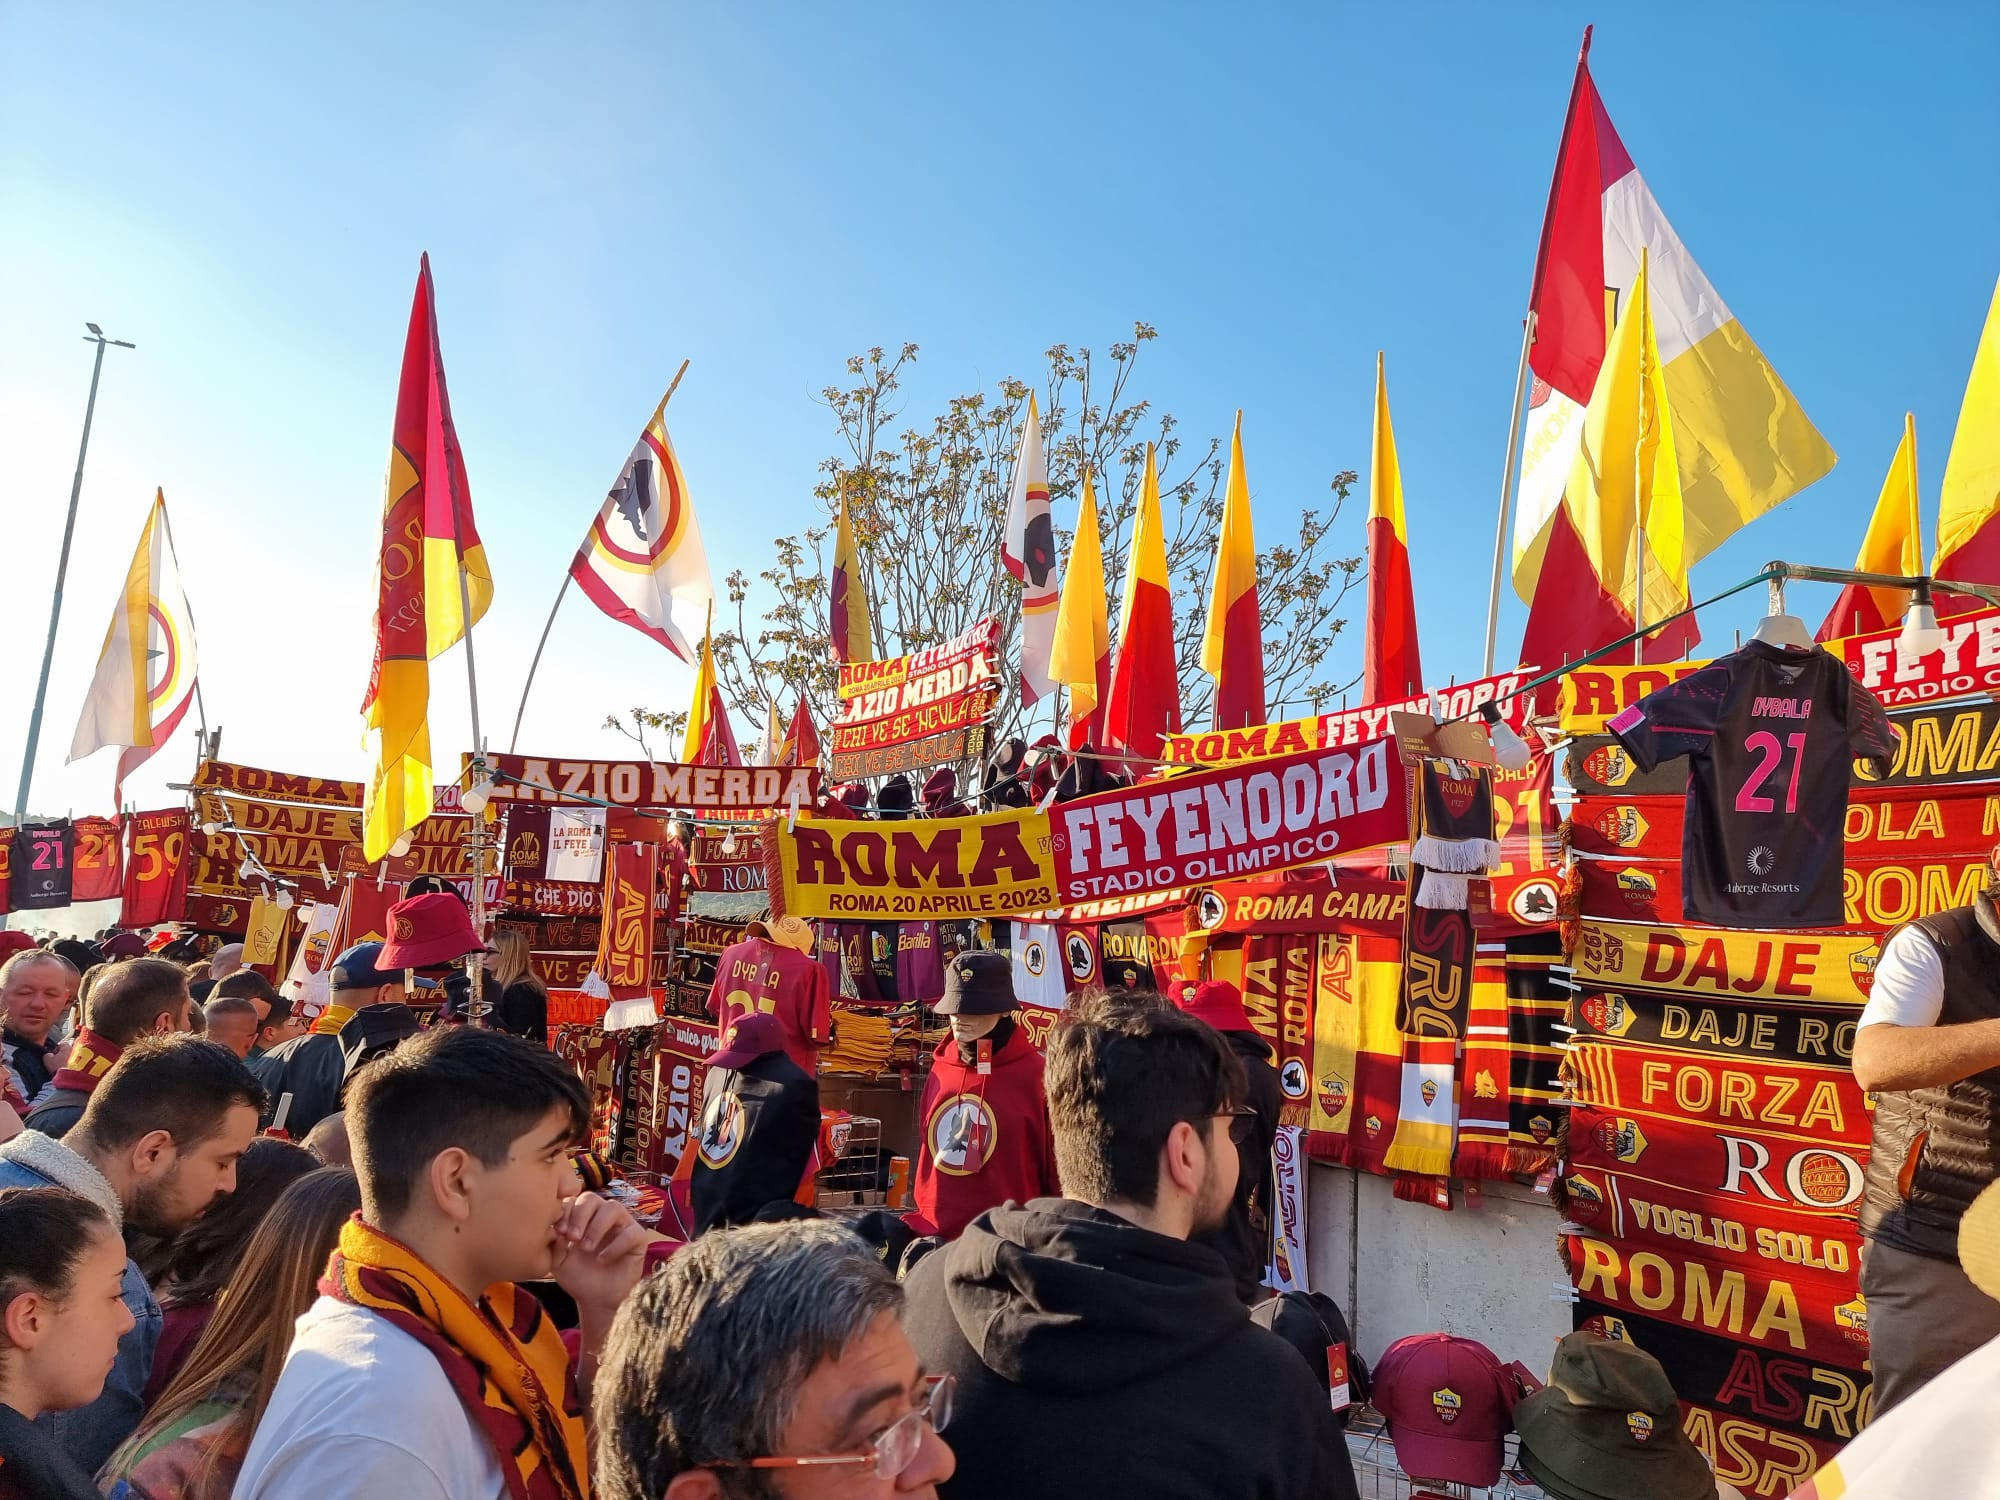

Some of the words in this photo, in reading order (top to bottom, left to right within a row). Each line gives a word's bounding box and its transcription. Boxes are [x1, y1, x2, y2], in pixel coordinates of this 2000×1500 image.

[840, 657, 904, 686] ROMA
[908, 663, 936, 678] STADIO
[938, 647, 980, 669] OLIMPICO
[833, 686, 899, 725] LAZIO
[901, 652, 991, 710] MERDA
[1875, 675, 1975, 704] TADIO
[1751, 696, 1813, 719] DYBALA
[842, 725, 867, 749] CHI
[872, 721, 888, 744] VE
[892, 714, 911, 740] SE
[1172, 722, 1309, 764] ROMA
[1852, 711, 2000, 782] OMA
[203, 762, 348, 800] ROMA
[484, 756, 641, 803] LAZIO
[653, 762, 813, 806] MERDA
[834, 753, 860, 778] CHI
[1493, 759, 1537, 784] BALA
[1596, 753, 1606, 781] ROMA
[1735, 730, 1808, 814] 21
[1442, 780, 1474, 797] ROMA
[245, 804, 336, 837] DAJE
[793, 821, 1041, 889] ROMA
[1063, 739, 1390, 874] FEYENOORD
[1606, 812, 1615, 841] ROMA
[1843, 800, 1945, 843] OLA
[553, 827, 565, 837] LA
[567, 827, 592, 837] ROMA
[32, 840, 64, 871] 21
[77, 834, 116, 869] 21
[134, 832, 184, 882] 59
[206, 833, 325, 867] ROMA
[509, 850, 540, 861] ROMA
[721, 866, 769, 891] ROM
[829, 894, 889, 913] ROMA
[892, 895, 916, 913] 20
[918, 892, 996, 913] APRILE
[998, 887, 1052, 910] 2023
[1069, 867, 1176, 899] STADIO
[1184, 829, 1341, 880] OLIMPICO
[534, 887, 561, 905] CHE
[567, 890, 594, 908] DIO
[1725, 882, 1760, 896] Auberge
[1761, 881, 1801, 894] Resorts
[1842, 863, 1990, 927] ROM
[1234, 893, 1314, 921] ROMA
[1322, 890, 1407, 921] CAMP
[612, 877, 646, 987] ASR
[898, 932, 932, 952] Barilla
[306, 954, 324, 964] ROM
[1149, 935, 1185, 962] ROM
[1582, 926, 1601, 975] 1927
[1603, 931, 1624, 974] ASR
[1640, 932, 1822, 997] DAJE
[732, 959, 780, 989] DYBLA
[1321, 935, 1353, 1005] AS
[1857, 975, 1874, 985] RO
[1284, 947, 1309, 1046] ROMA
[1593, 997, 1602, 1028] ROMA
[676, 1027, 701, 1045] unico
[701, 1034, 719, 1055] gra
[1660, 1003, 1779, 1051] DAJE
[1797, 1017, 1857, 1058] RO
[1321, 1097, 1344, 1106] ROMA
[1642, 1060, 1846, 1132] FORZA
[636, 1069, 654, 1168] FORZA
[664, 1065, 692, 1161] AZIO
[1604, 1122, 1616, 1152] ROMA
[1715, 1133, 1866, 1208] RO
[1573, 1200, 1600, 1213] ROMA
[1629, 1198, 1748, 1253] VOGLIO
[1755, 1227, 1850, 1273] SOLO
[1577, 1237, 1807, 1350] ROMA
[1844, 1331, 1872, 1344] ROM
[1436, 1406, 1458, 1416] ROMA
[1630, 1426, 1651, 1437] ROMA
[1683, 1407, 1818, 1497] ASR
